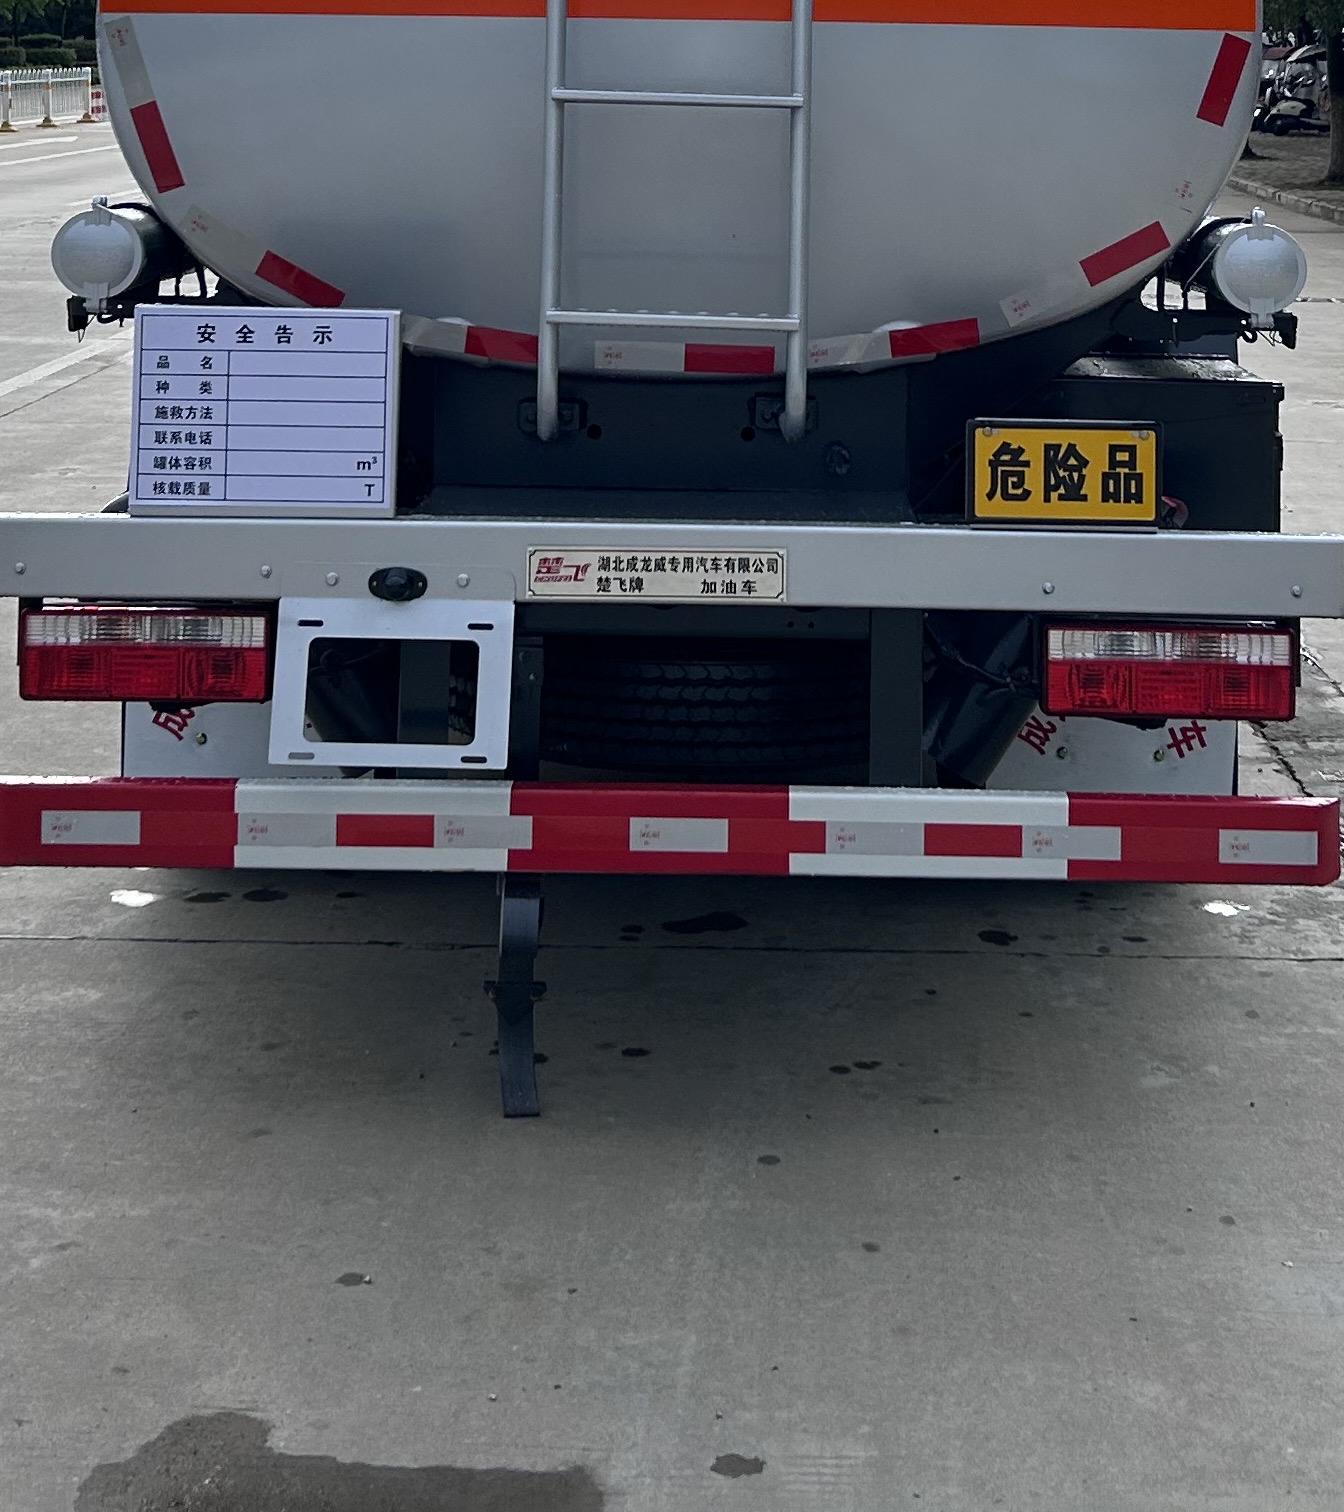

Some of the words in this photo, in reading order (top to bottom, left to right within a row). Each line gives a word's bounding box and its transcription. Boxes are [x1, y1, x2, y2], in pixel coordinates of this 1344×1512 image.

[195, 323, 334, 345] 安全告示
[154, 404, 214, 421] 施救方法
[153, 430, 214, 446] 联系电话
[152, 455, 213, 471] 罐体容积
[985, 440, 1144, 504] 危险品
[152, 480, 212, 497] 核载质量
[363, 483, 376, 497] T
[597, 554, 779, 575] 湖北成龙威专用汽车有限公司
[596, 575, 645, 594] 楚飞牌
[700, 578, 758, 596] 加油车
